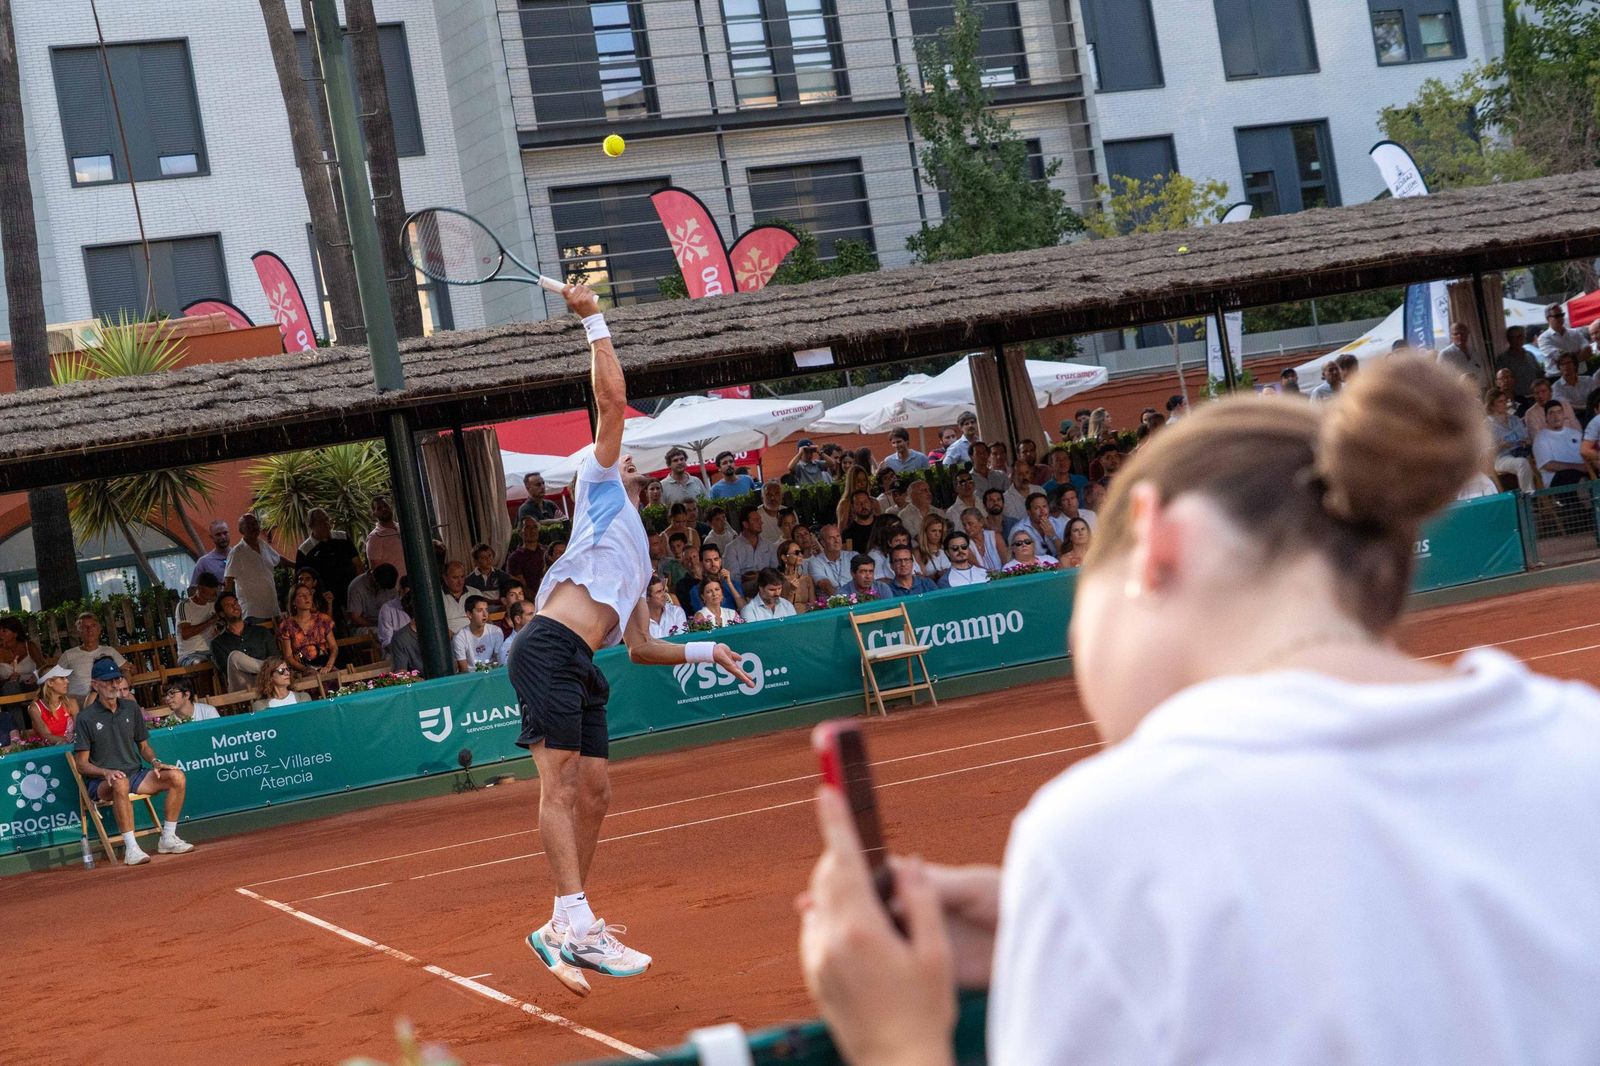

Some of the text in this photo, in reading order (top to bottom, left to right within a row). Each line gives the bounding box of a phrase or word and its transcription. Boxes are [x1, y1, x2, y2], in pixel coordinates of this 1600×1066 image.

[771, 404, 814, 416] Cruzcampo
[460, 703, 520, 727] JUAN
[211, 728, 277, 749] Montero
[175, 744, 267, 772] Aramburu &
[216, 752, 332, 782] Gómez-Villares
[260, 771, 313, 790] Atencia
[0, 810, 81, 837] PROCISA
